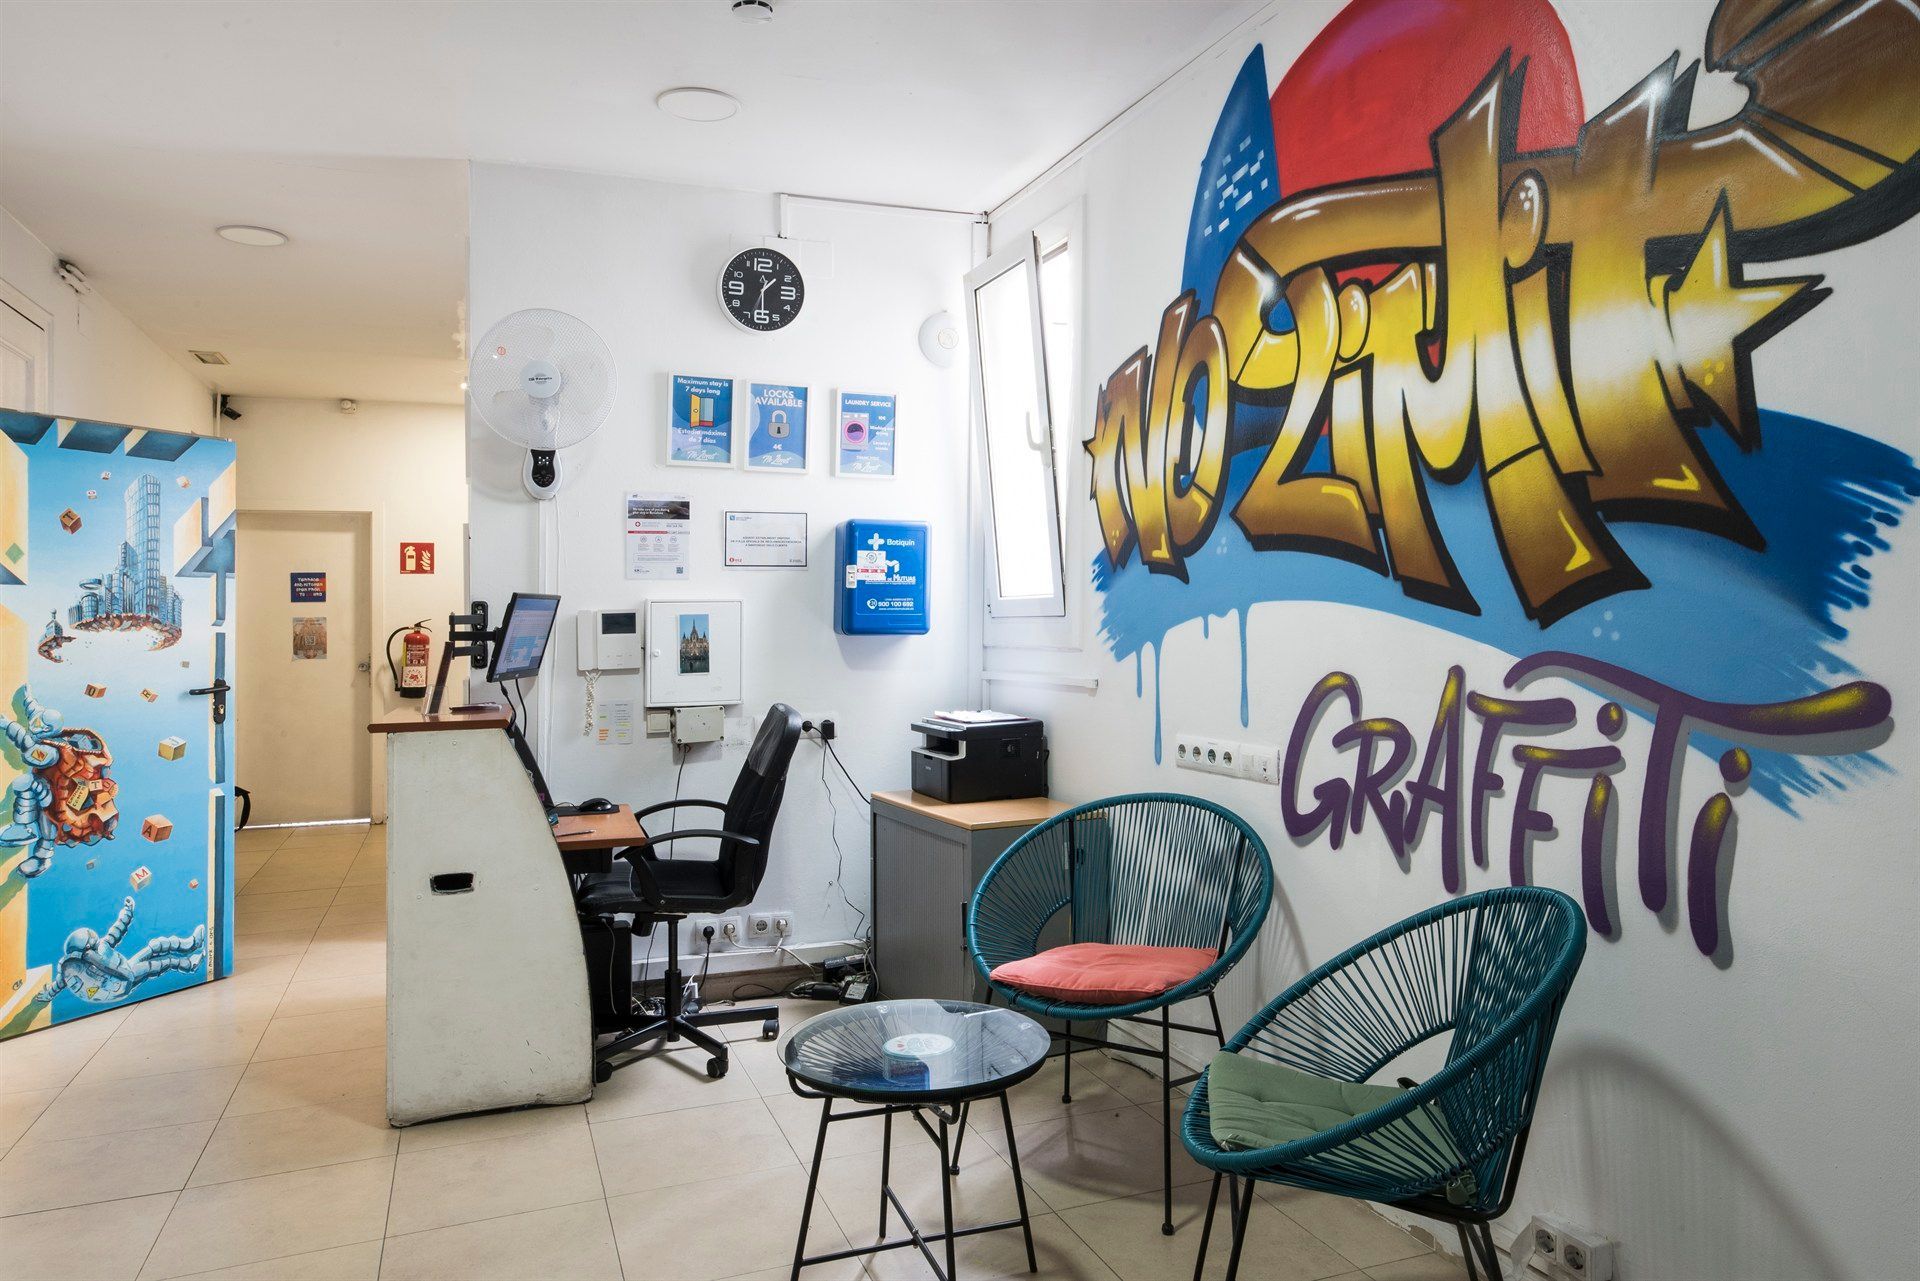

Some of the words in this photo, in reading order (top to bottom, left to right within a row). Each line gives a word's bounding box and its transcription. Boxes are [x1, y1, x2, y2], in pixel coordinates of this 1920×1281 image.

[753, 258, 773, 272] 12
[728, 281, 744, 295] 9
[780, 286, 796, 300] 3
[732, 299, 740, 307] 8
[743, 311, 751, 319] 7
[753, 309, 770, 324] 6
[677, 378, 708, 386] Maximum
[691, 386, 706, 394] days
[763, 389, 795, 399] LOCKS
[755, 397, 803, 408] AVAILABLE
[1083, 288, 1231, 584] NO
[63, 510, 75, 520] T
[141, 688, 151, 699] R
[91, 781, 100, 789] T
[143, 825, 152, 838] A
[135, 868, 149, 880] M
